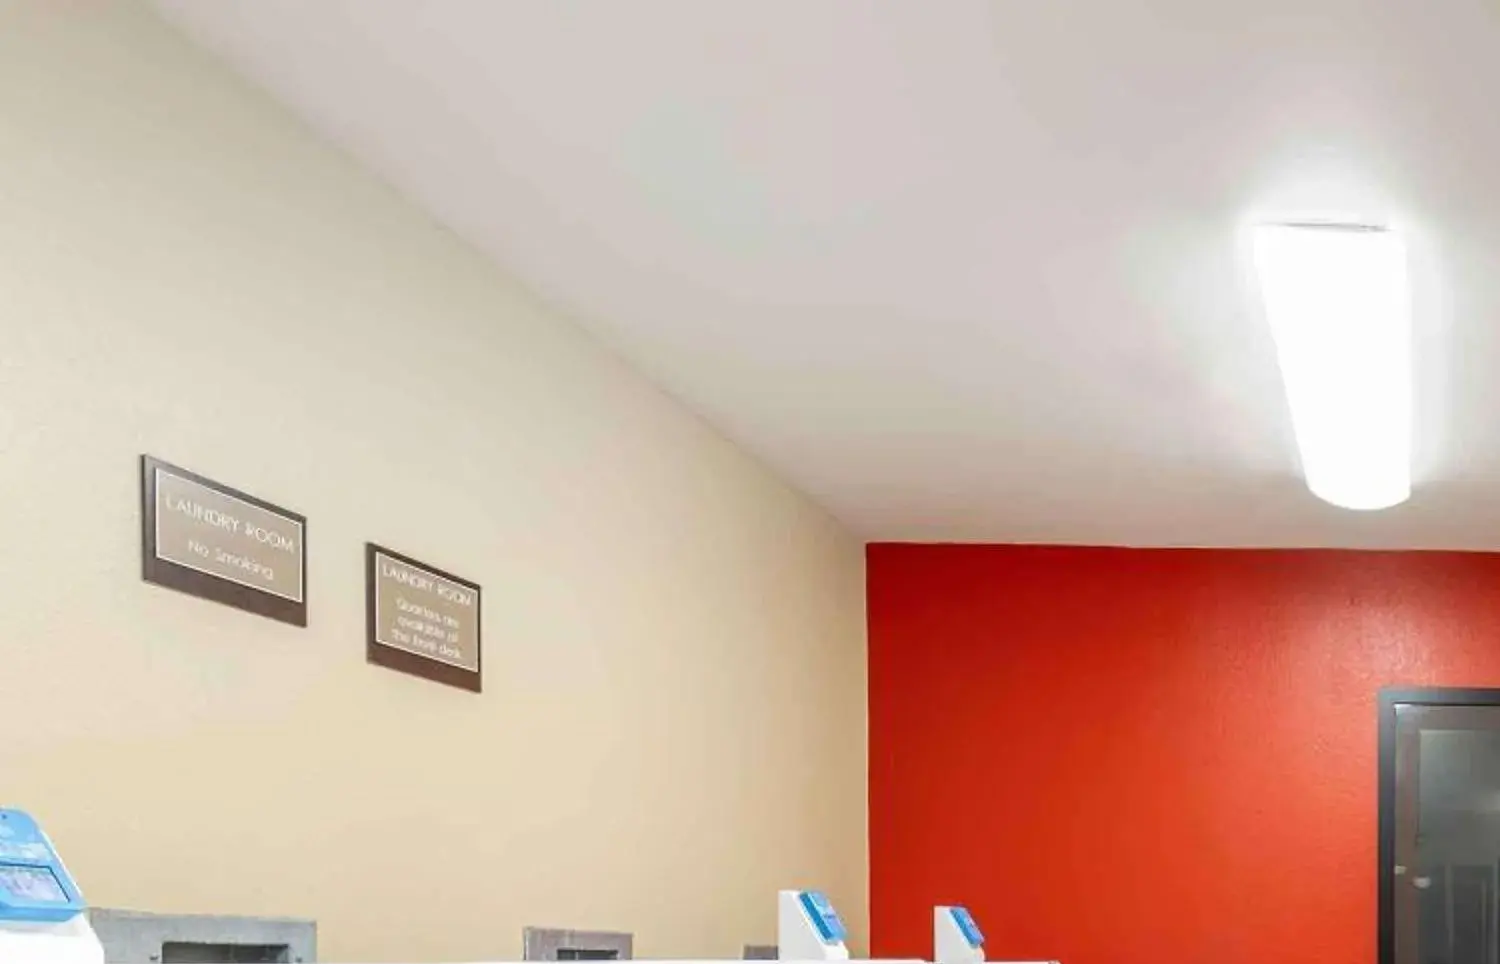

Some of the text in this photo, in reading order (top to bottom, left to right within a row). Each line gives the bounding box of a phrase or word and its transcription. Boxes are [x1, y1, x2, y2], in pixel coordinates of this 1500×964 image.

[165, 493, 295, 555] LAUNDRY ROOM
[188, 539, 274, 580] No Smoking
[382, 563, 472, 606] LAUNDRY ROOM
